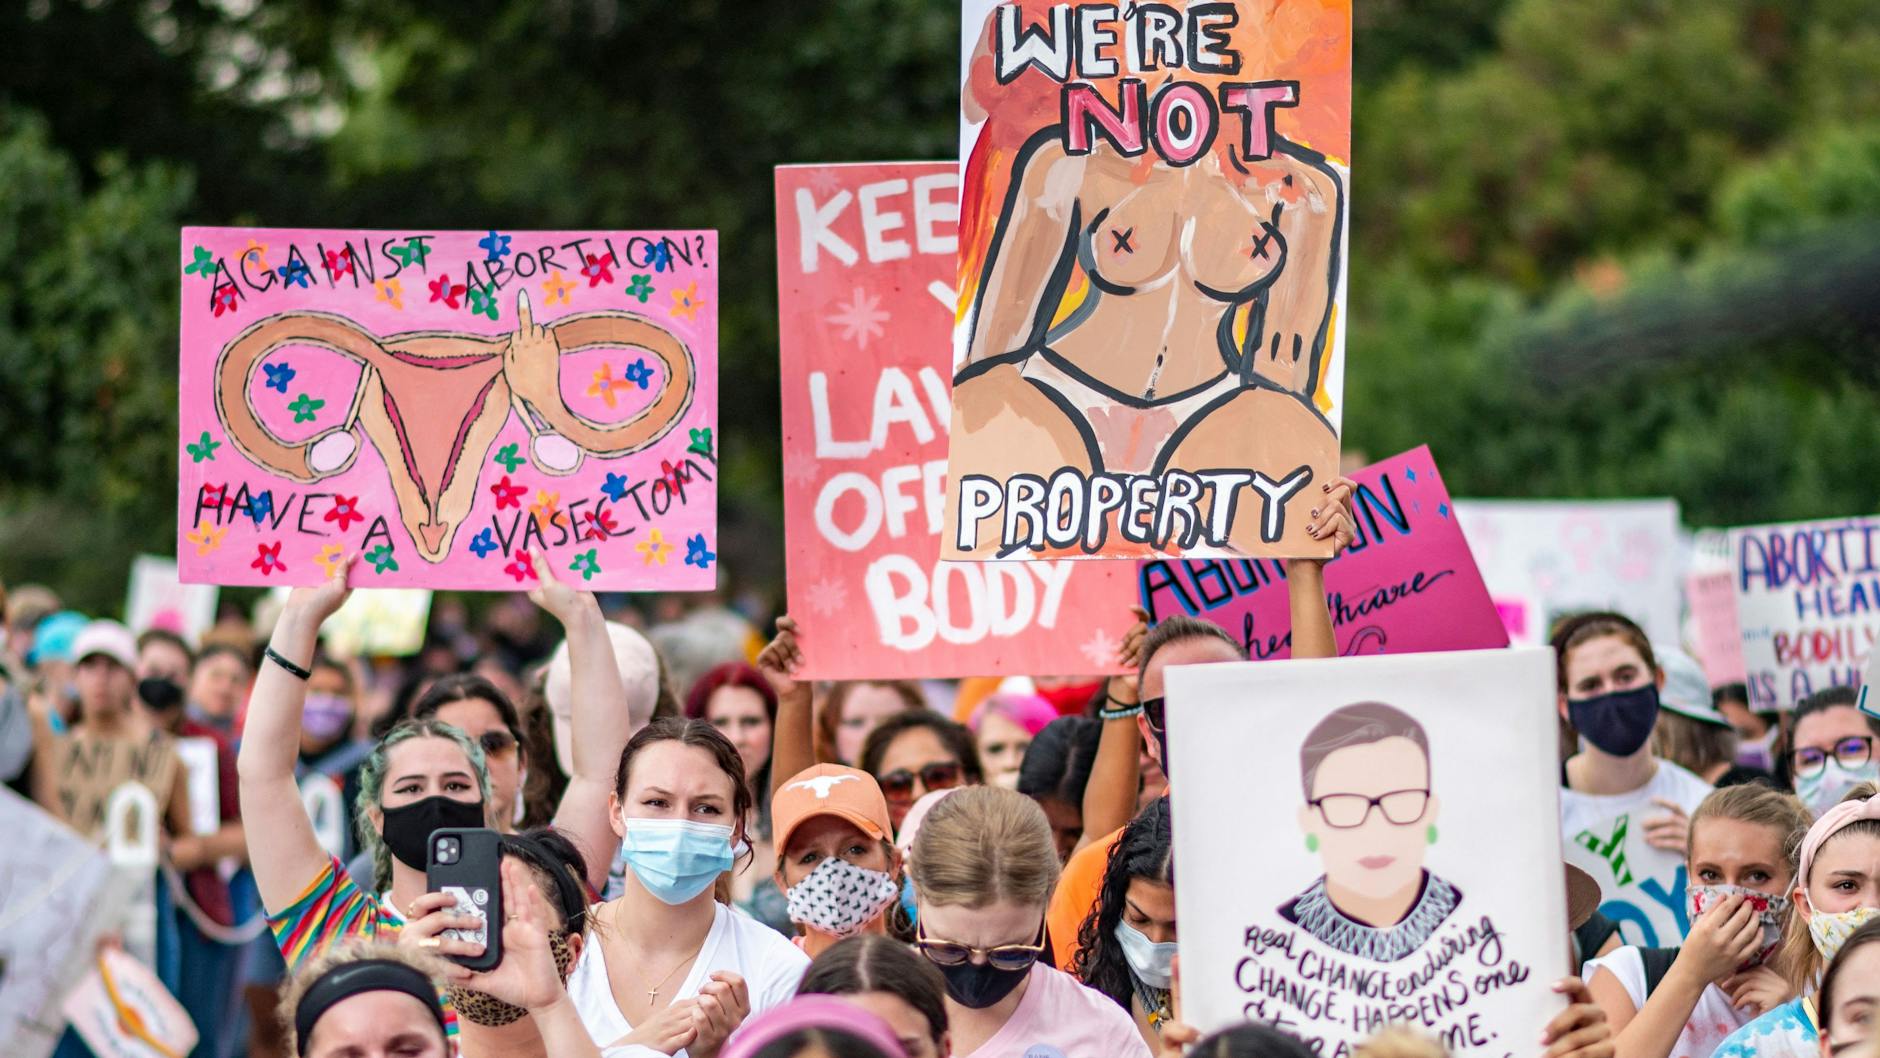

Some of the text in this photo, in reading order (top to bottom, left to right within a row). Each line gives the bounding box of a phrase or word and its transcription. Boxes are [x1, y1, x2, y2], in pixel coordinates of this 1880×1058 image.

[995, 2, 1244, 86] WE'RE
[1060, 78, 1301, 168] NOT
[210, 235, 709, 312] AGAINST ABORTION?
[193, 482, 337, 538] HAVE
[361, 515, 396, 551] A
[956, 465, 1314, 560] PROPERTY
[864, 554, 1074, 652] BODY
[1396, 915, 1507, 997] enduring
[1474, 960, 1531, 995] one
